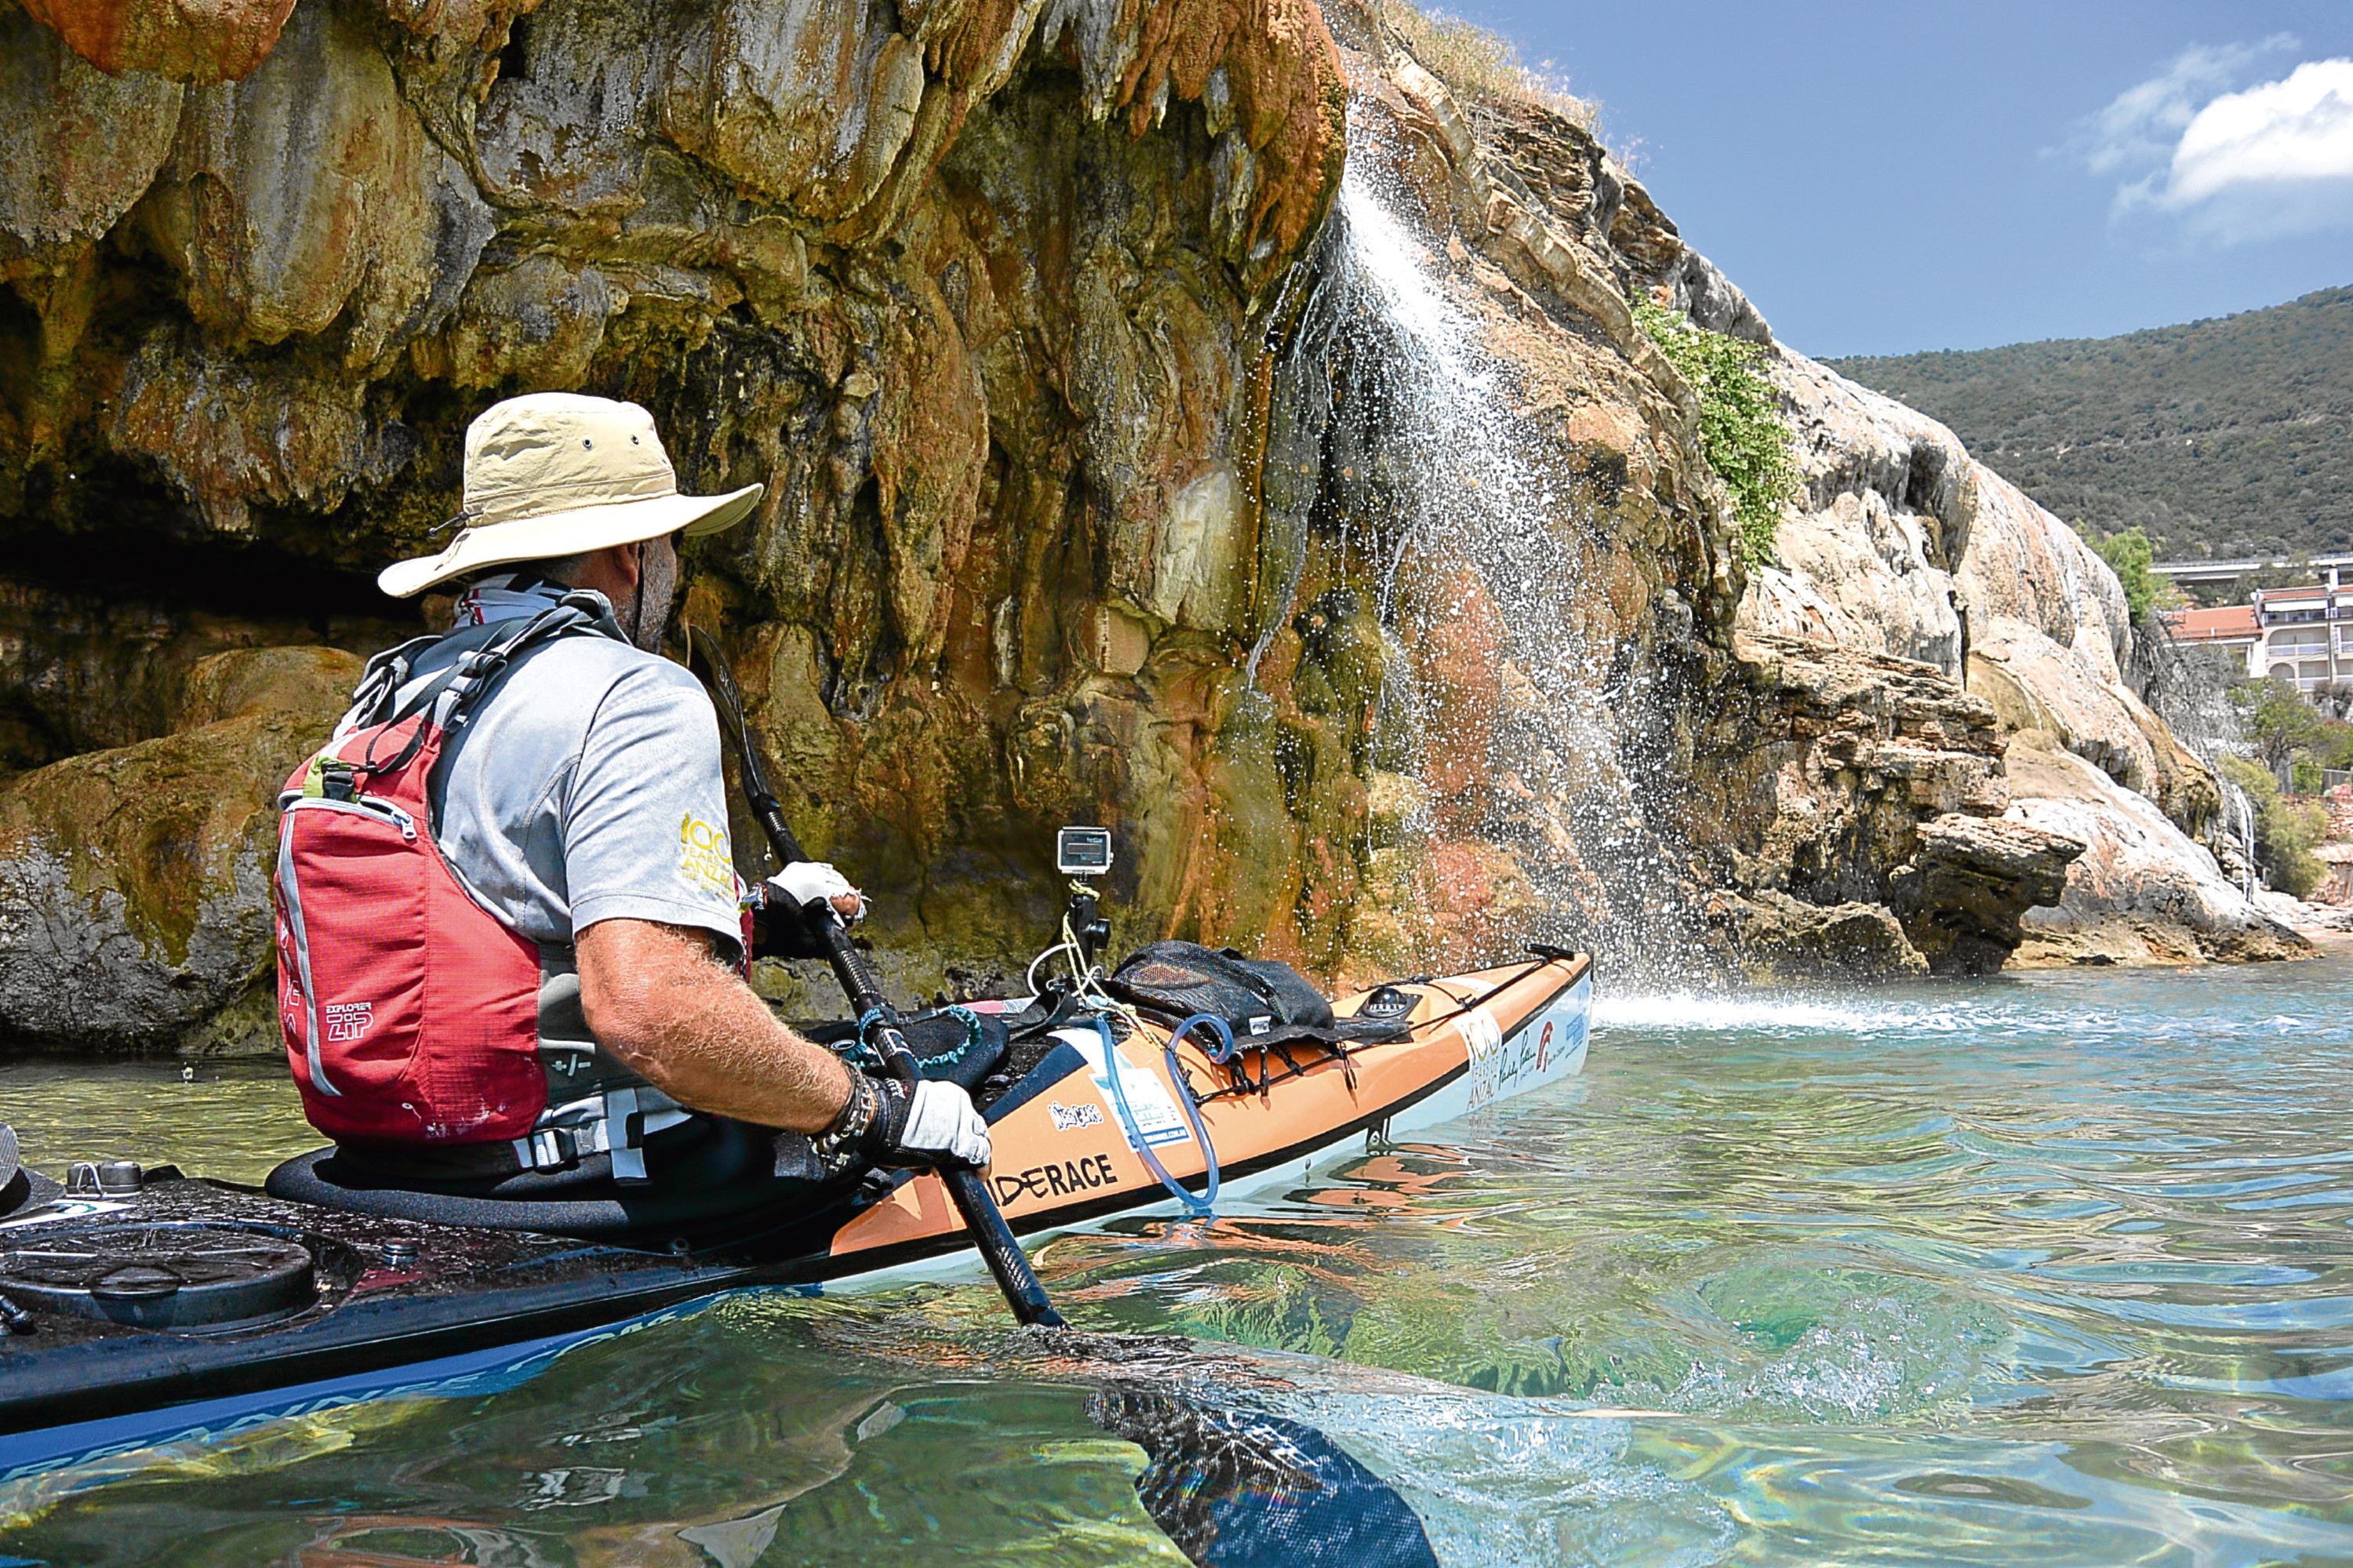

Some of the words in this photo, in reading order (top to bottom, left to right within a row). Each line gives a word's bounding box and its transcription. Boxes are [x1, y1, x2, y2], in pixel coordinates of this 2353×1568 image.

[681, 812, 732, 864] 100
[682, 846, 719, 867] YEARS
[681, 857, 734, 893] ANZAC
[325, 1002, 372, 1013] EXPLORER
[325, 1011, 374, 1042] ZIP
[1471, 1060, 1490, 1084] YEARS
[1466, 1074, 1498, 1111] ANZAC
[986, 1153, 1118, 1208] IDERACE
